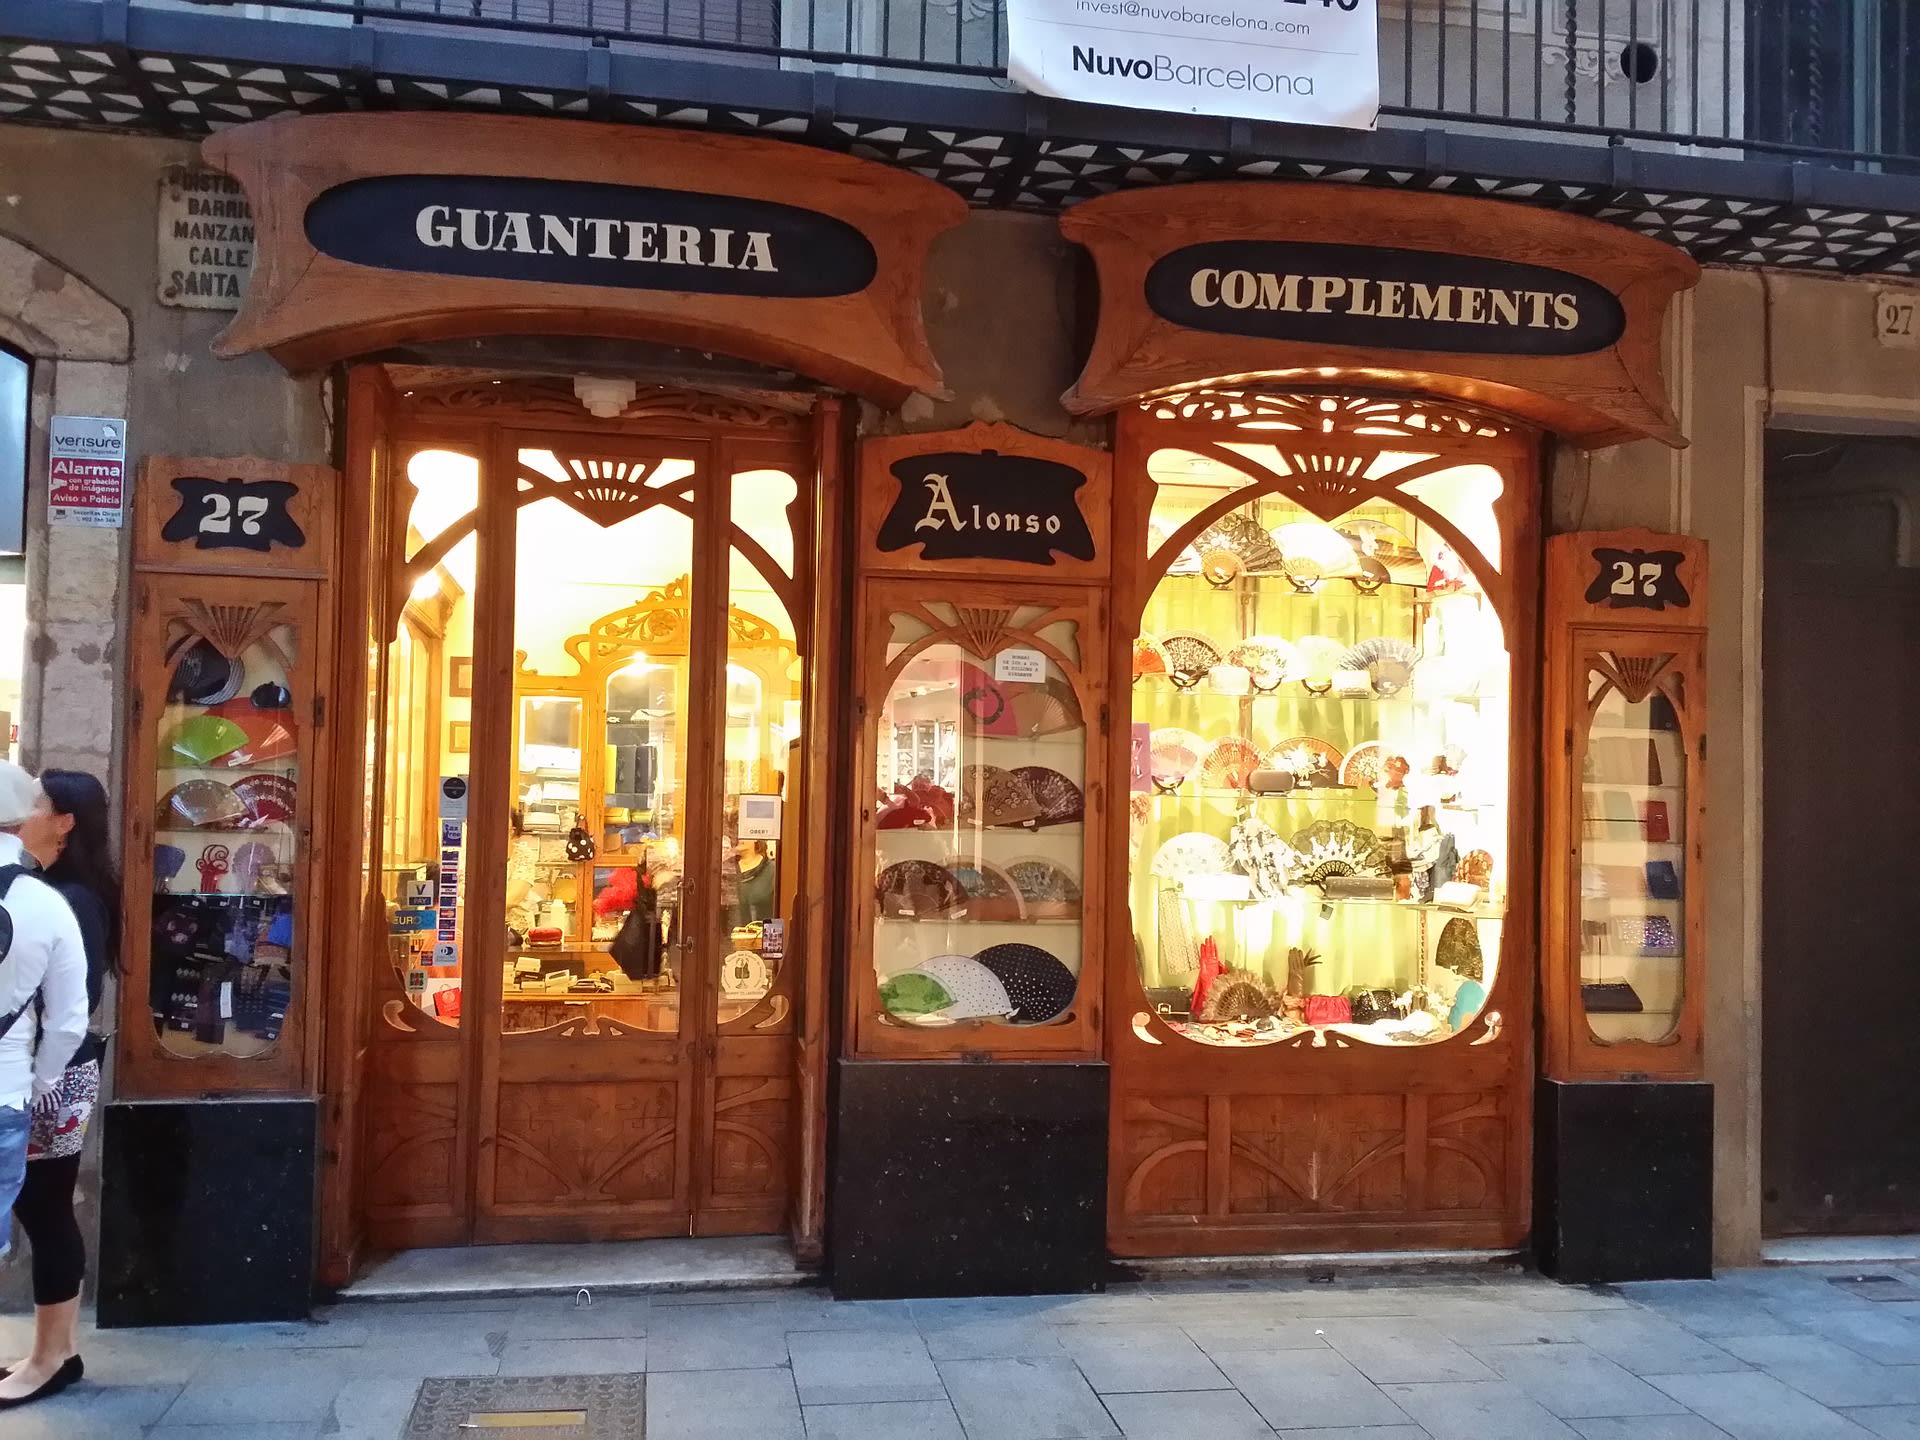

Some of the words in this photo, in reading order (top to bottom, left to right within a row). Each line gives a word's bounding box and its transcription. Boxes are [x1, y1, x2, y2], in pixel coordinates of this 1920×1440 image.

[1076, 0, 1310, 34] invest@nuvobarcelona.com
[1072, 45, 1314, 96] NuvoBarcelona
[415, 205, 779, 273] GUANTERIA
[189, 246, 249, 268] CALLE
[171, 270, 241, 298] SANTA
[1190, 268, 1580, 331] COMPLEMENTS
[1885, 304, 1914, 336] 27
[55, 435, 121, 448] verisure
[53, 461, 120, 477] Alarma
[53, 493, 79, 502] Aviso
[915, 473, 1061, 535] Alonso
[199, 493, 269, 536] 27
[1611, 561, 1662, 597] 27
[416, 884, 426, 895] V
